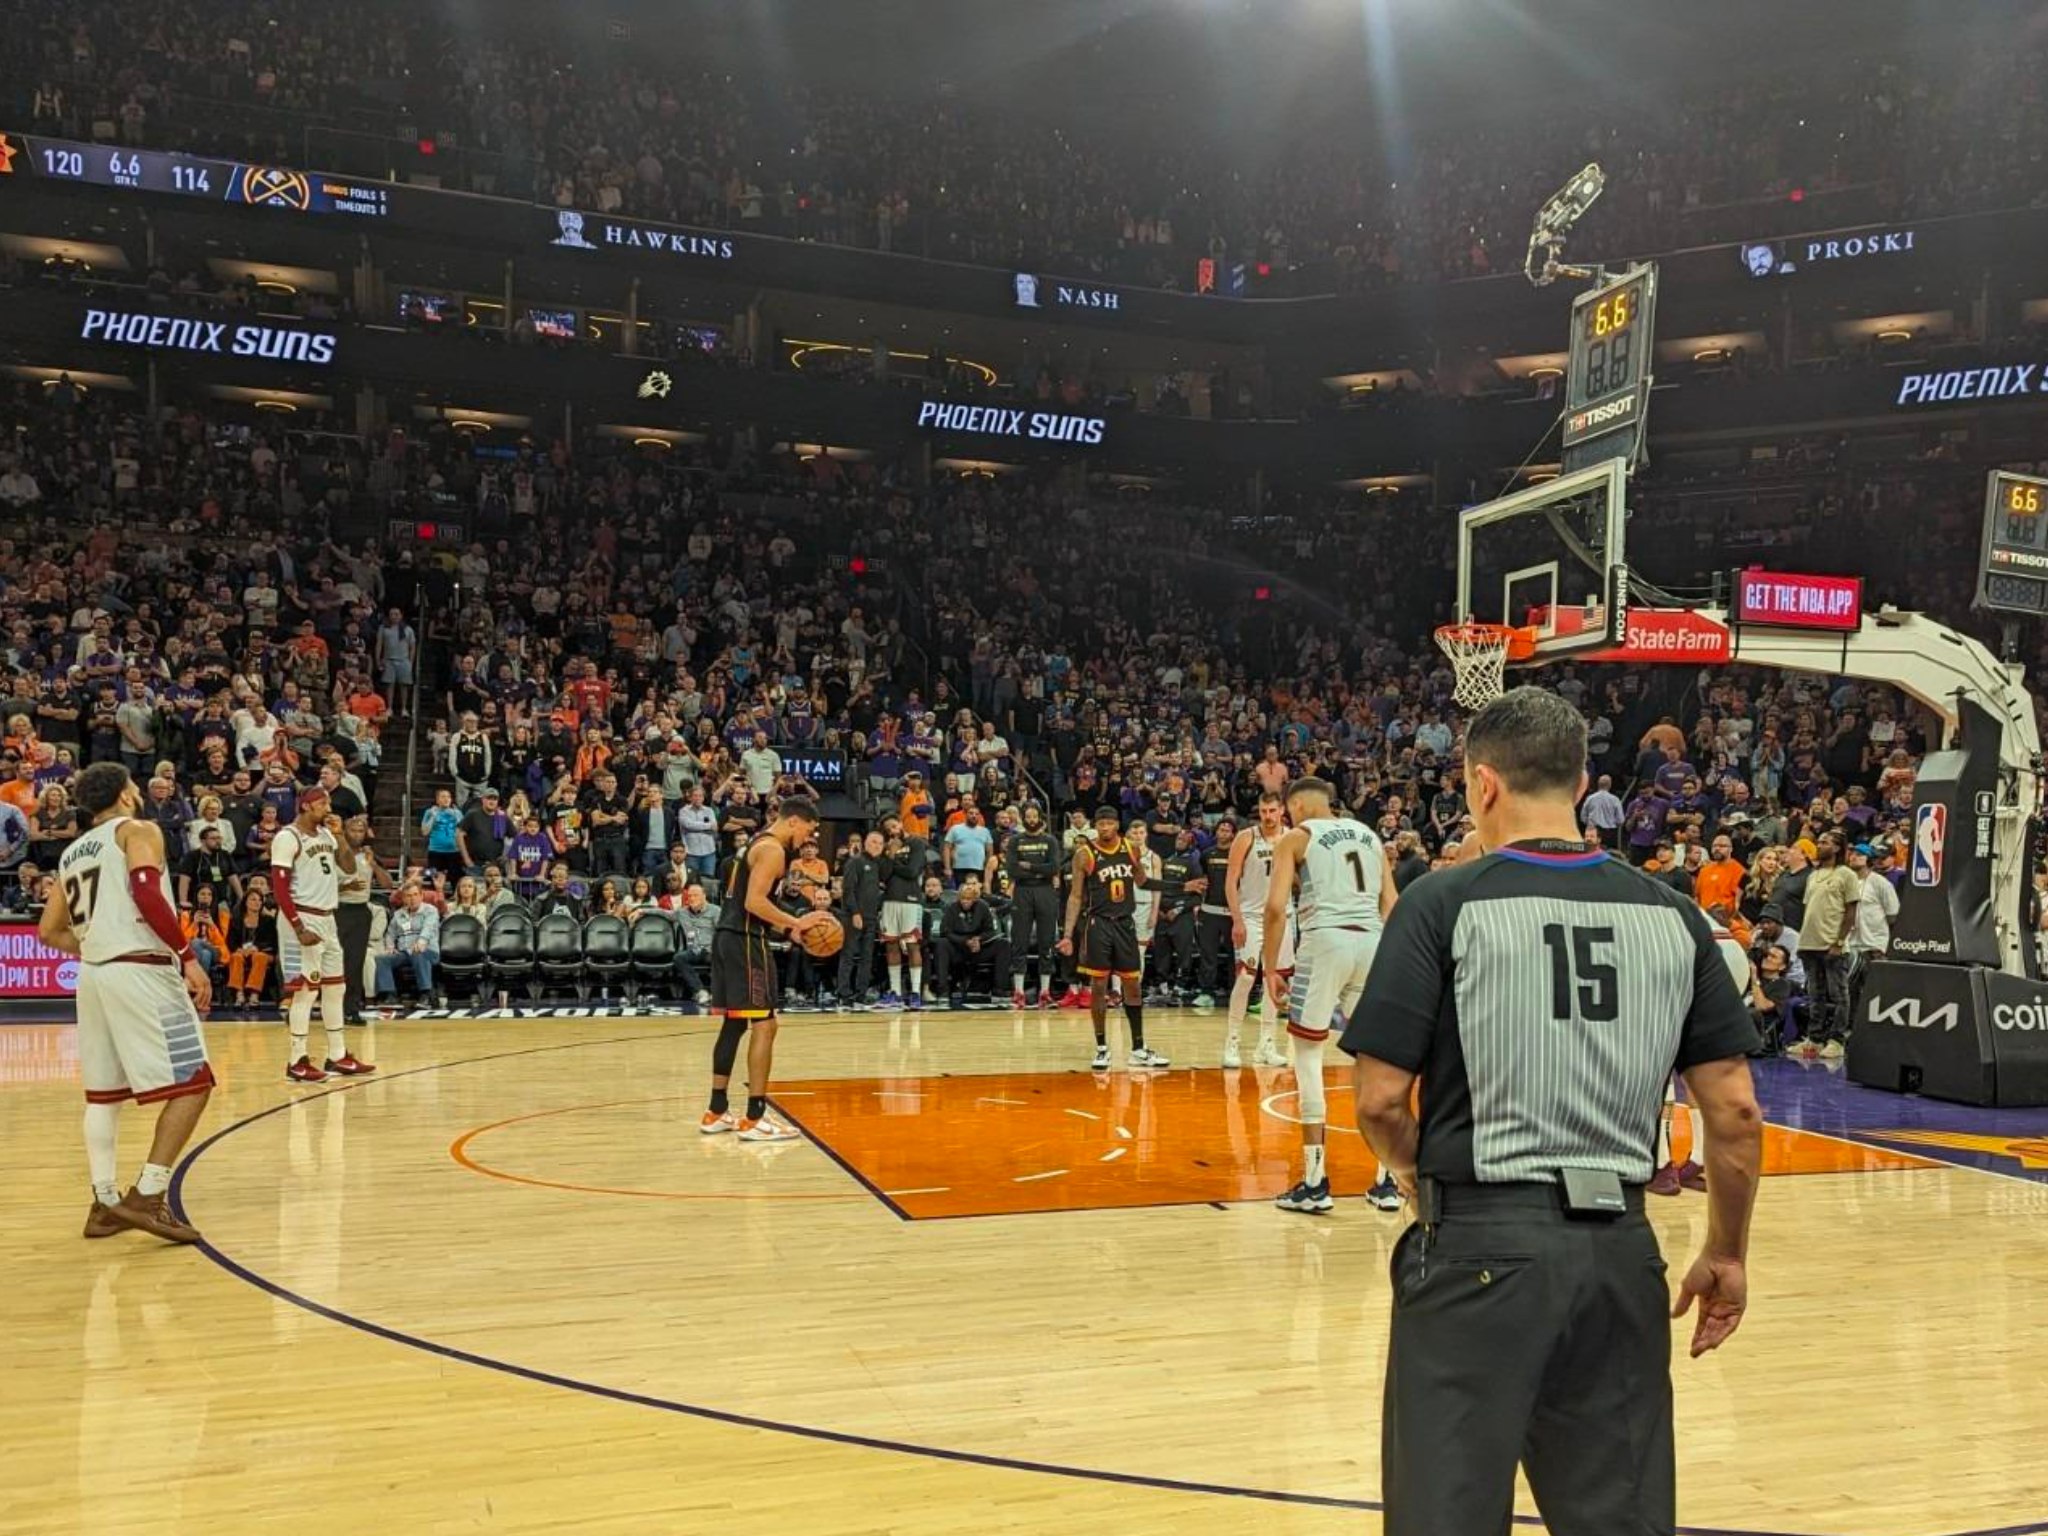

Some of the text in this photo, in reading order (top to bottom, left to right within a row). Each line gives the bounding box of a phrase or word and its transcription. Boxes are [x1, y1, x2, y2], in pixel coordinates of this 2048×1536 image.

[44, 149, 83, 176] 120
[110, 152, 141, 176] 6.6
[172, 166, 210, 192] 114
[335, 199, 376, 215] TIMEOUTS
[350, 188, 376, 199] FOULS
[606, 225, 733, 258] HAWKINS
[1808, 231, 1914, 261] PROSKI
[1059, 286, 1120, 309] NASH
[1595, 293, 1627, 337] 6.6
[81, 309, 227, 351] PHOENIX
[1897, 364, 2037, 405] PHOENIX
[918, 401, 1024, 435] PHOENIX
[1586, 395, 1635, 426] TISSOT
[1616, 568, 1628, 642] SUNS.COM
[1746, 583, 1853, 615] GET THE NBA APP
[783, 758, 840, 775] TITAN
[320, 856, 331, 875] 5
[1098, 863, 1134, 883] PHX
[1345, 851, 1366, 893] 1
[65, 864, 101, 926] 27
[1110, 879, 1125, 903] 0
[1893, 937, 1951, 954] Google Pixel
[33, 966, 50, 988] ET
[1543, 923, 1619, 1022] 15
[406, 1006, 684, 1019] PLAYOFFS
[1868, 994, 1959, 1032] KIA
